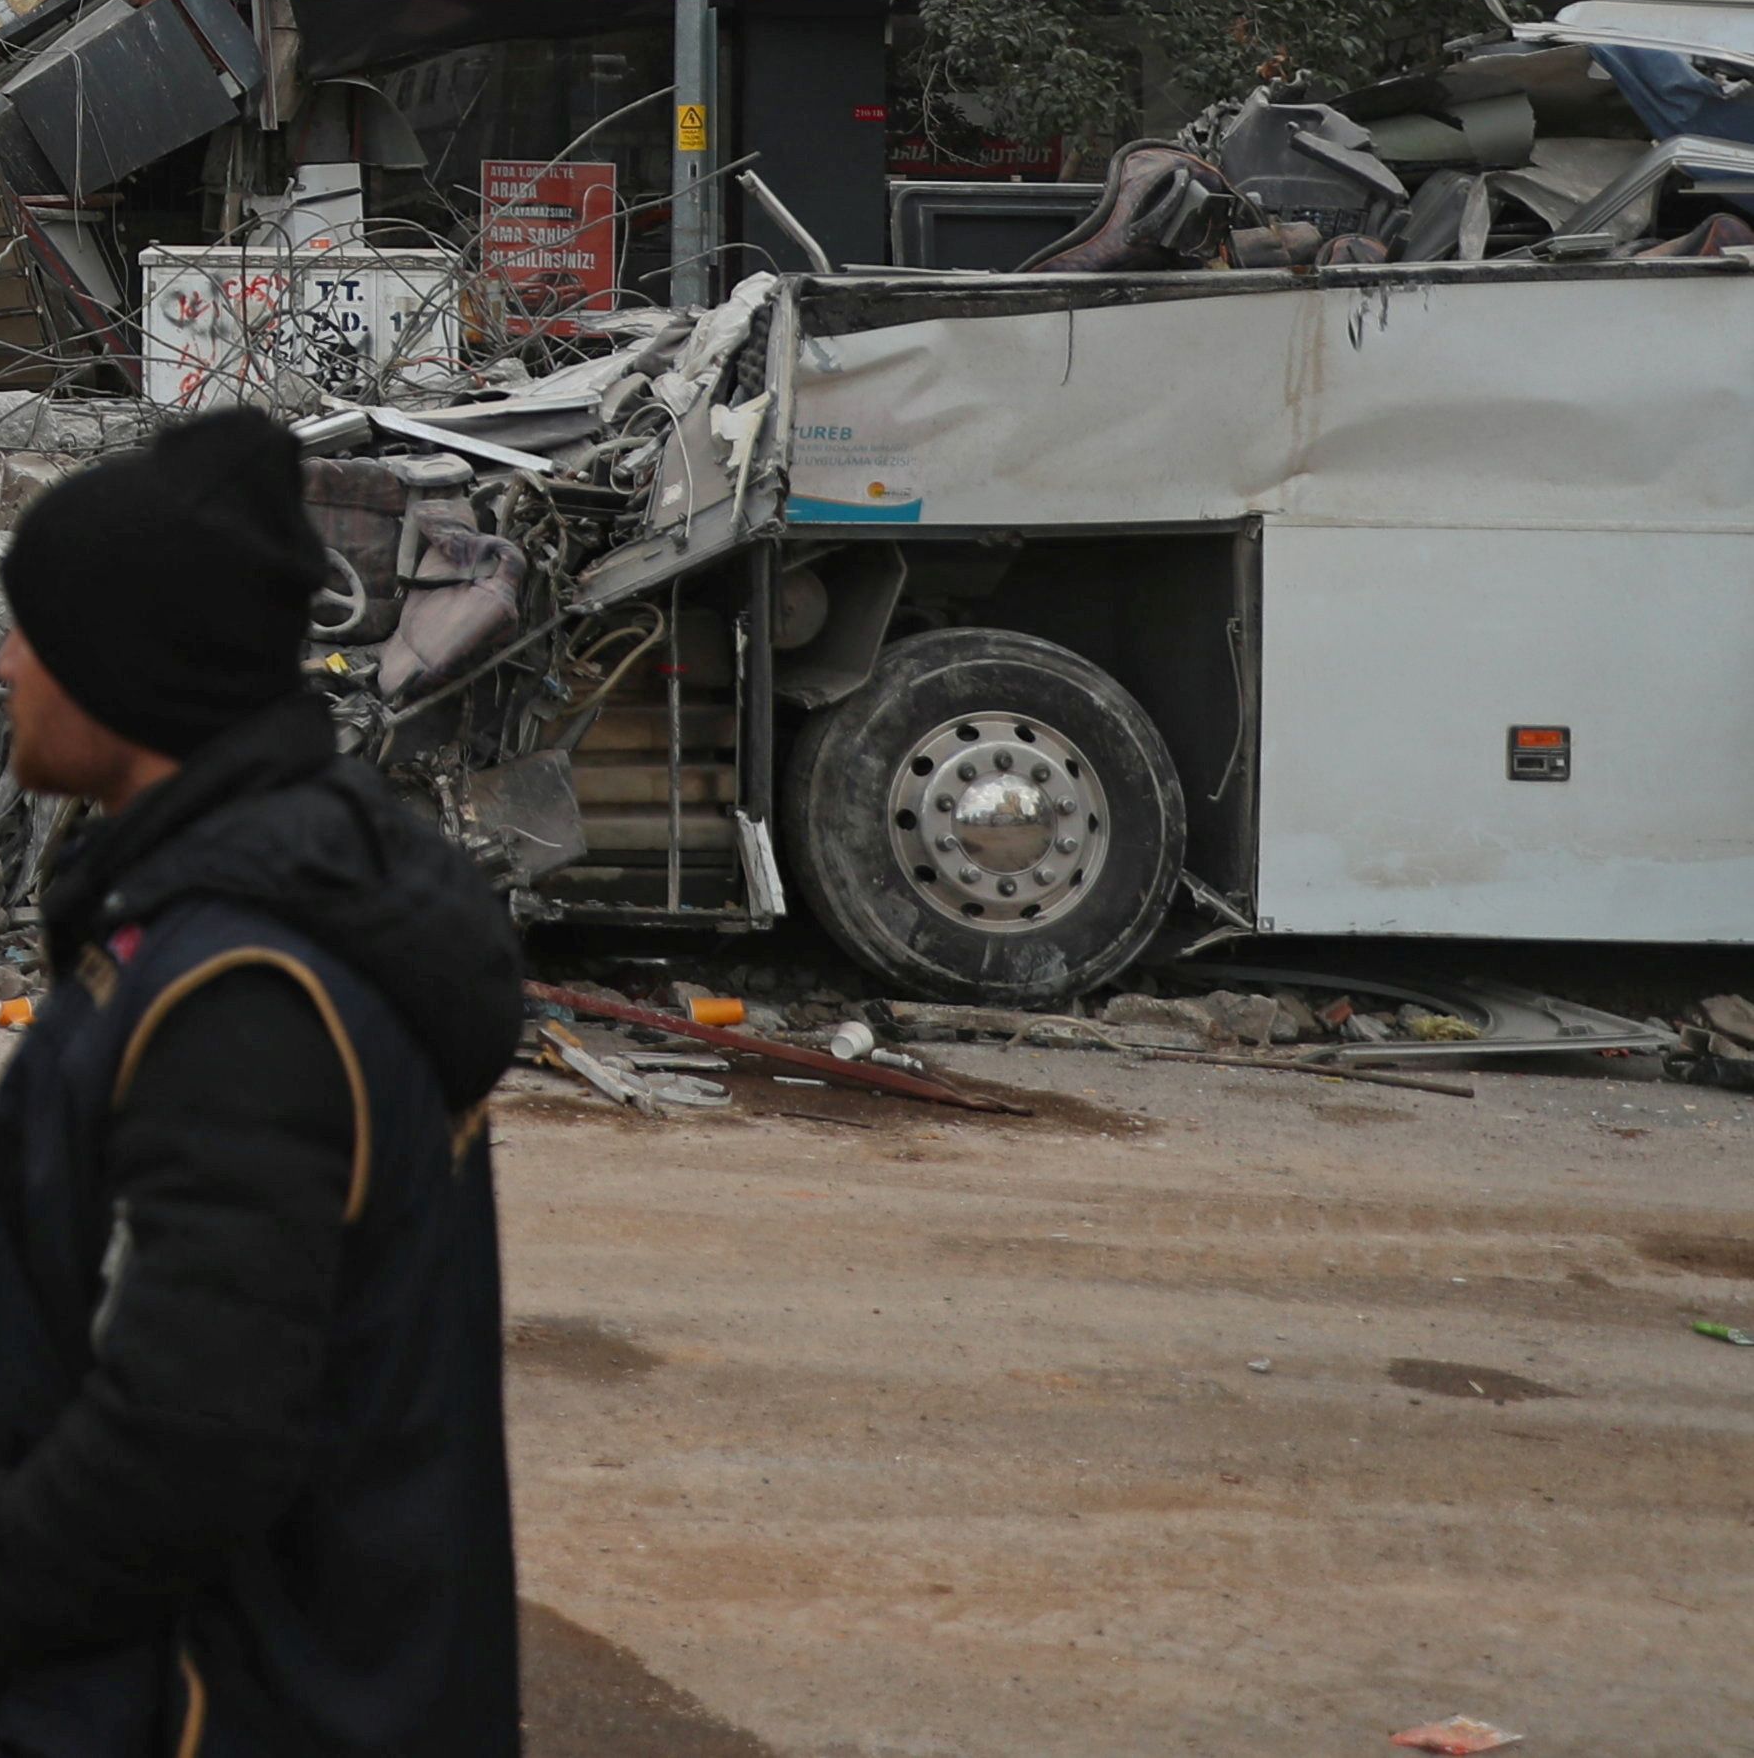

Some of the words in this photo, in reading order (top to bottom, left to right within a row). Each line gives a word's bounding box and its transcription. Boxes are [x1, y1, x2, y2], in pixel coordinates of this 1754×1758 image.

[490, 166, 516, 178] AYDA
[490, 181, 537, 198] ARABA
[490, 226, 522, 242] AMA
